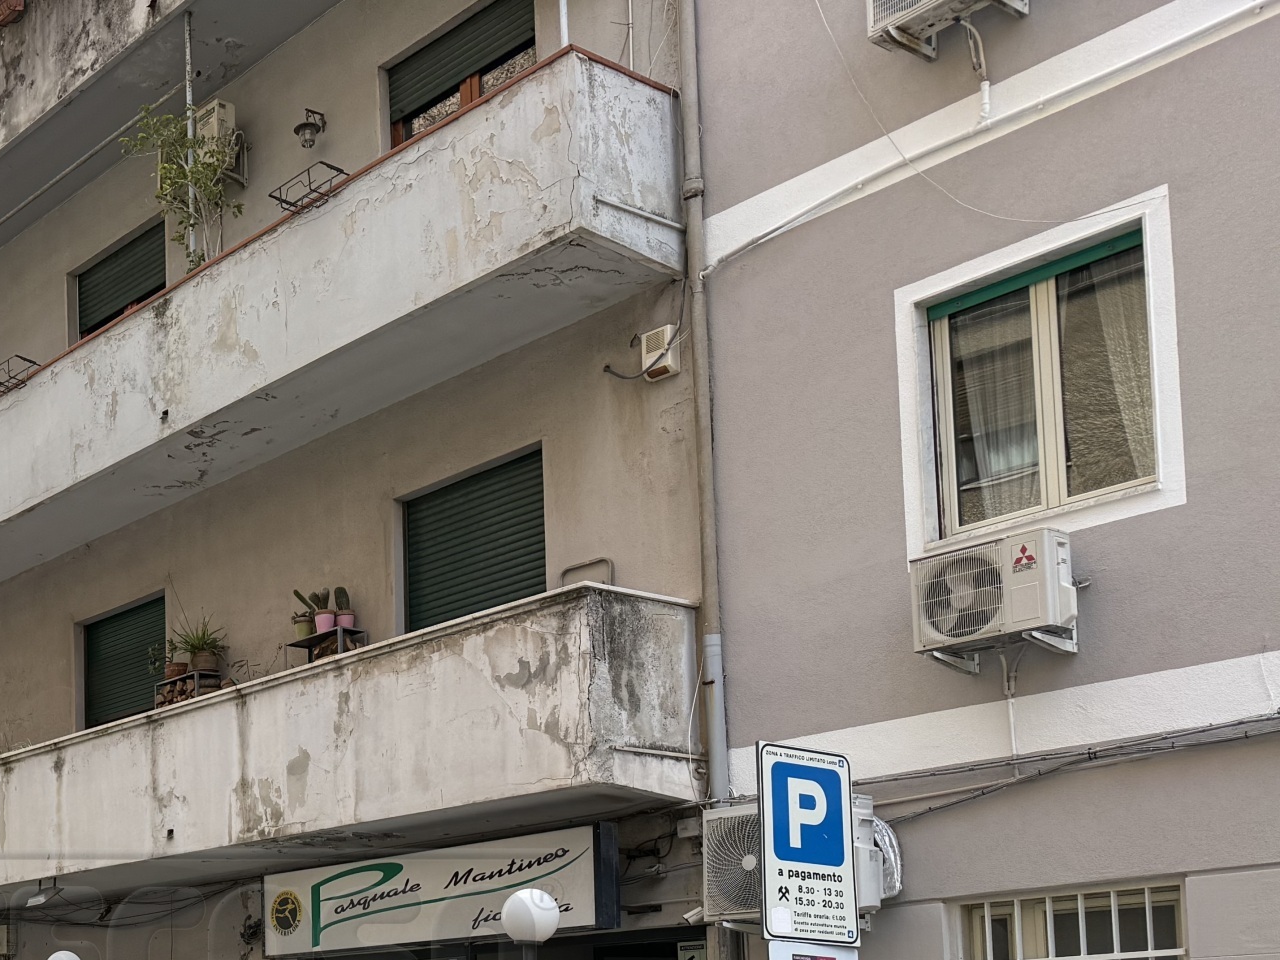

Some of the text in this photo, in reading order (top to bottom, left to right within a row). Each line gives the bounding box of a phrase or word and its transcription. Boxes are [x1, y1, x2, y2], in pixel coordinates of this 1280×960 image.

[784, 753, 805, 761] TRAFFICO
[788, 776, 828, 849] P
[778, 868, 843, 883] a pagamento
[798, 885, 815, 894] 8.30
[311, 847, 570, 948] Pasquale Mantineo
[794, 897, 815, 907] 15.30
[822, 900, 844, 910] 20.30
[273, 920, 301, 936] INTERFLORA
